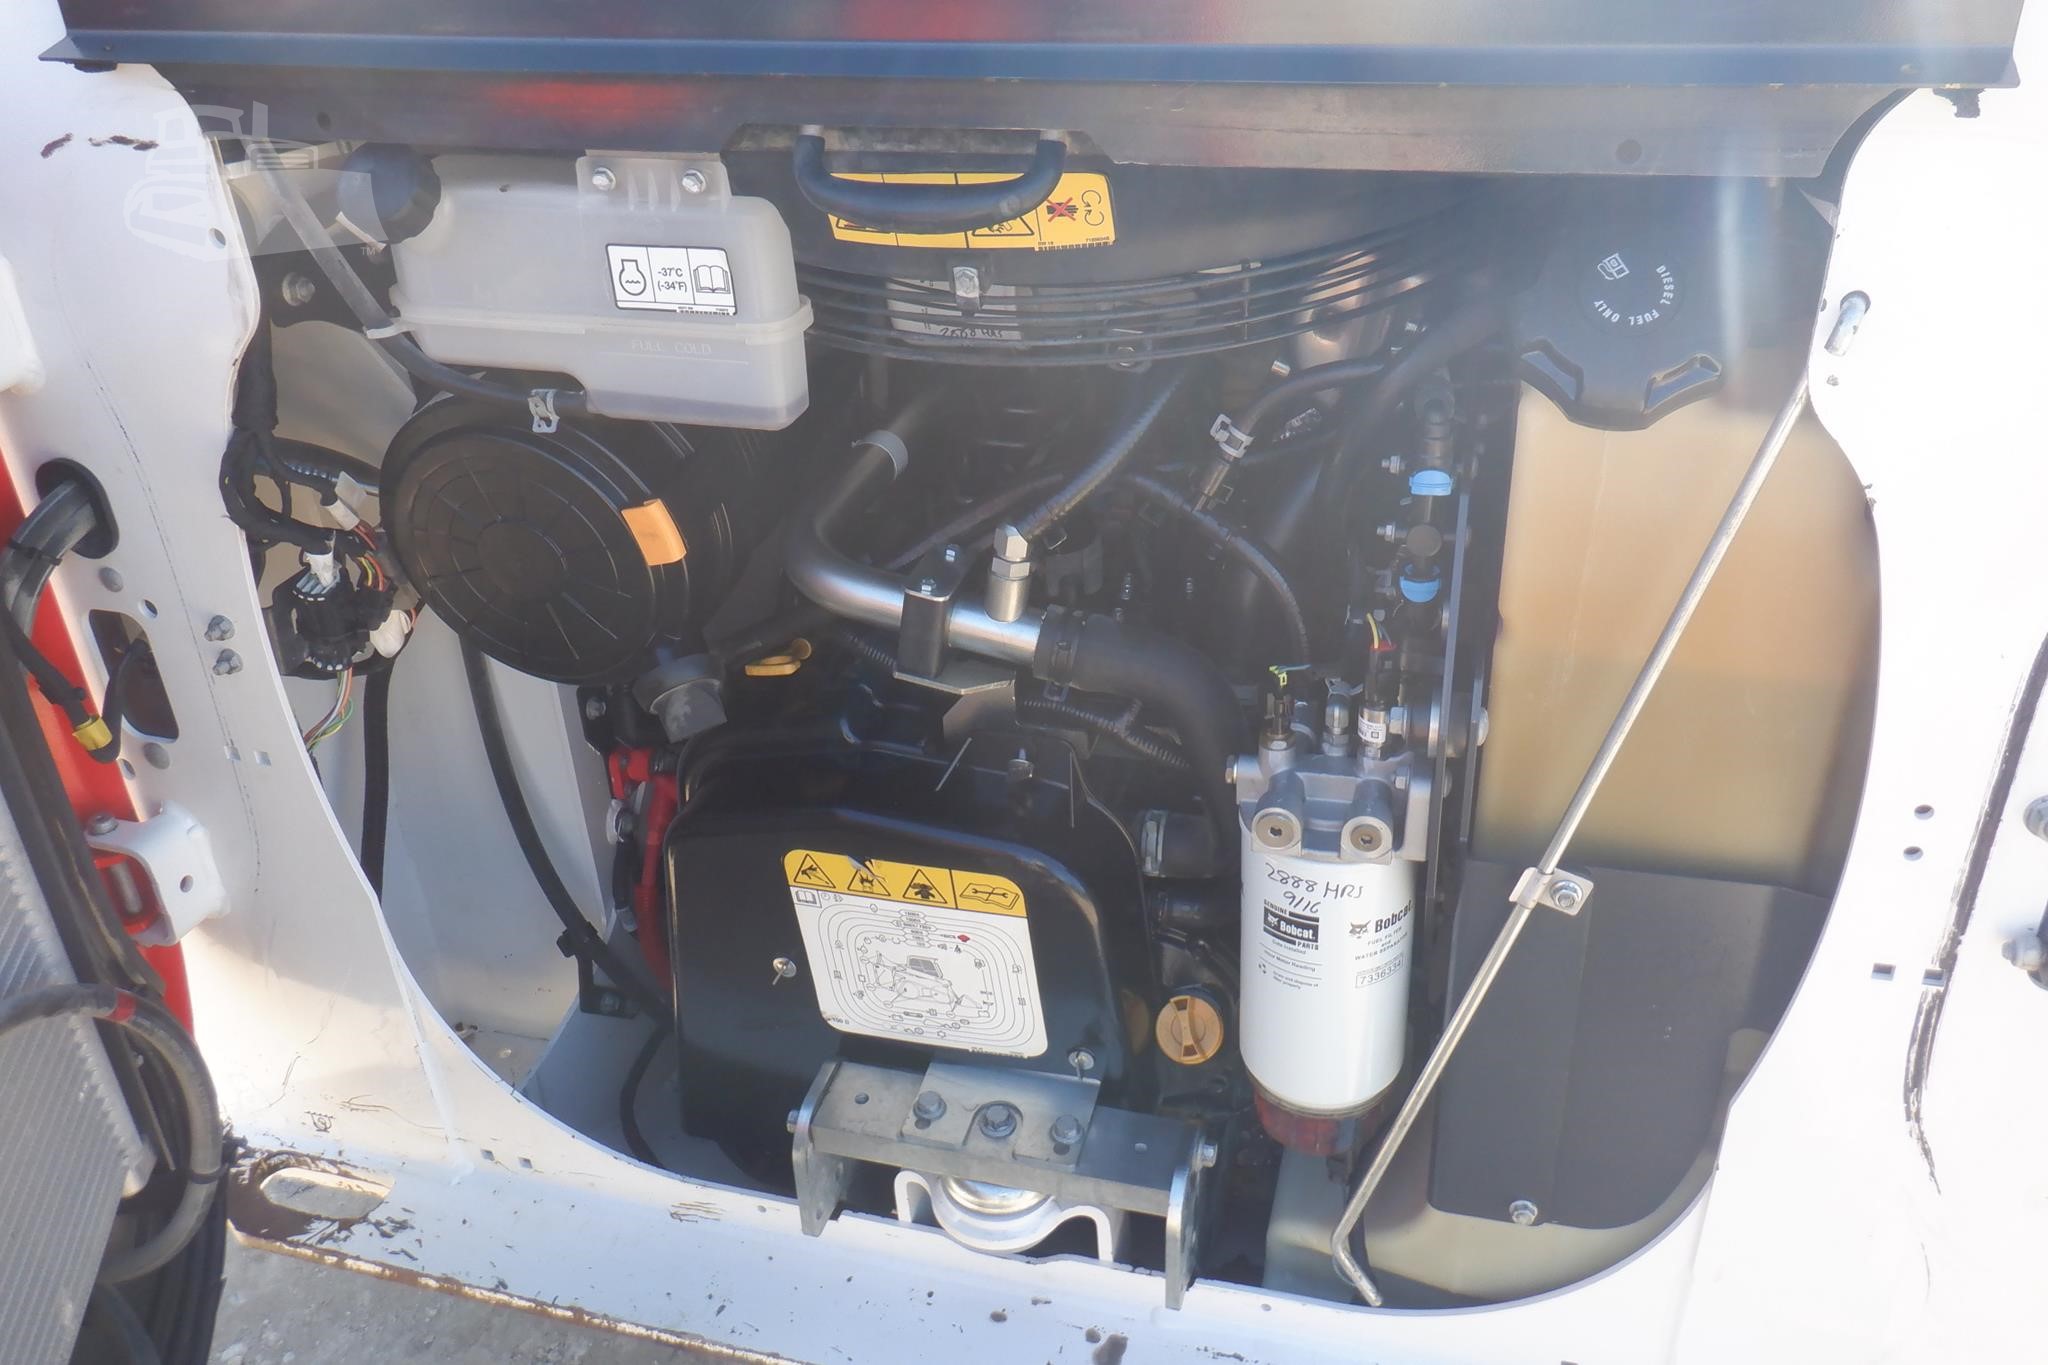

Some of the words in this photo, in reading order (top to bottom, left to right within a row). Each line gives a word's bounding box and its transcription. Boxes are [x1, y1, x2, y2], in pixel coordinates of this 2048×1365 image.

[1656, 264, 1675, 305] DIESEL
[1593, 300, 1620, 322] ONLY
[1628, 309, 1660, 326] FUEL
[1265, 862, 1318, 892] 2888
[1322, 881, 1364, 900] HRS
[1264, 899, 1287, 915] GENUINE
[1375, 900, 1411, 933] Bobcat
[1280, 920, 1315, 939] Bobcat
[1297, 940, 1319, 951] PARTS
[1355, 950, 1378, 960] WATER
